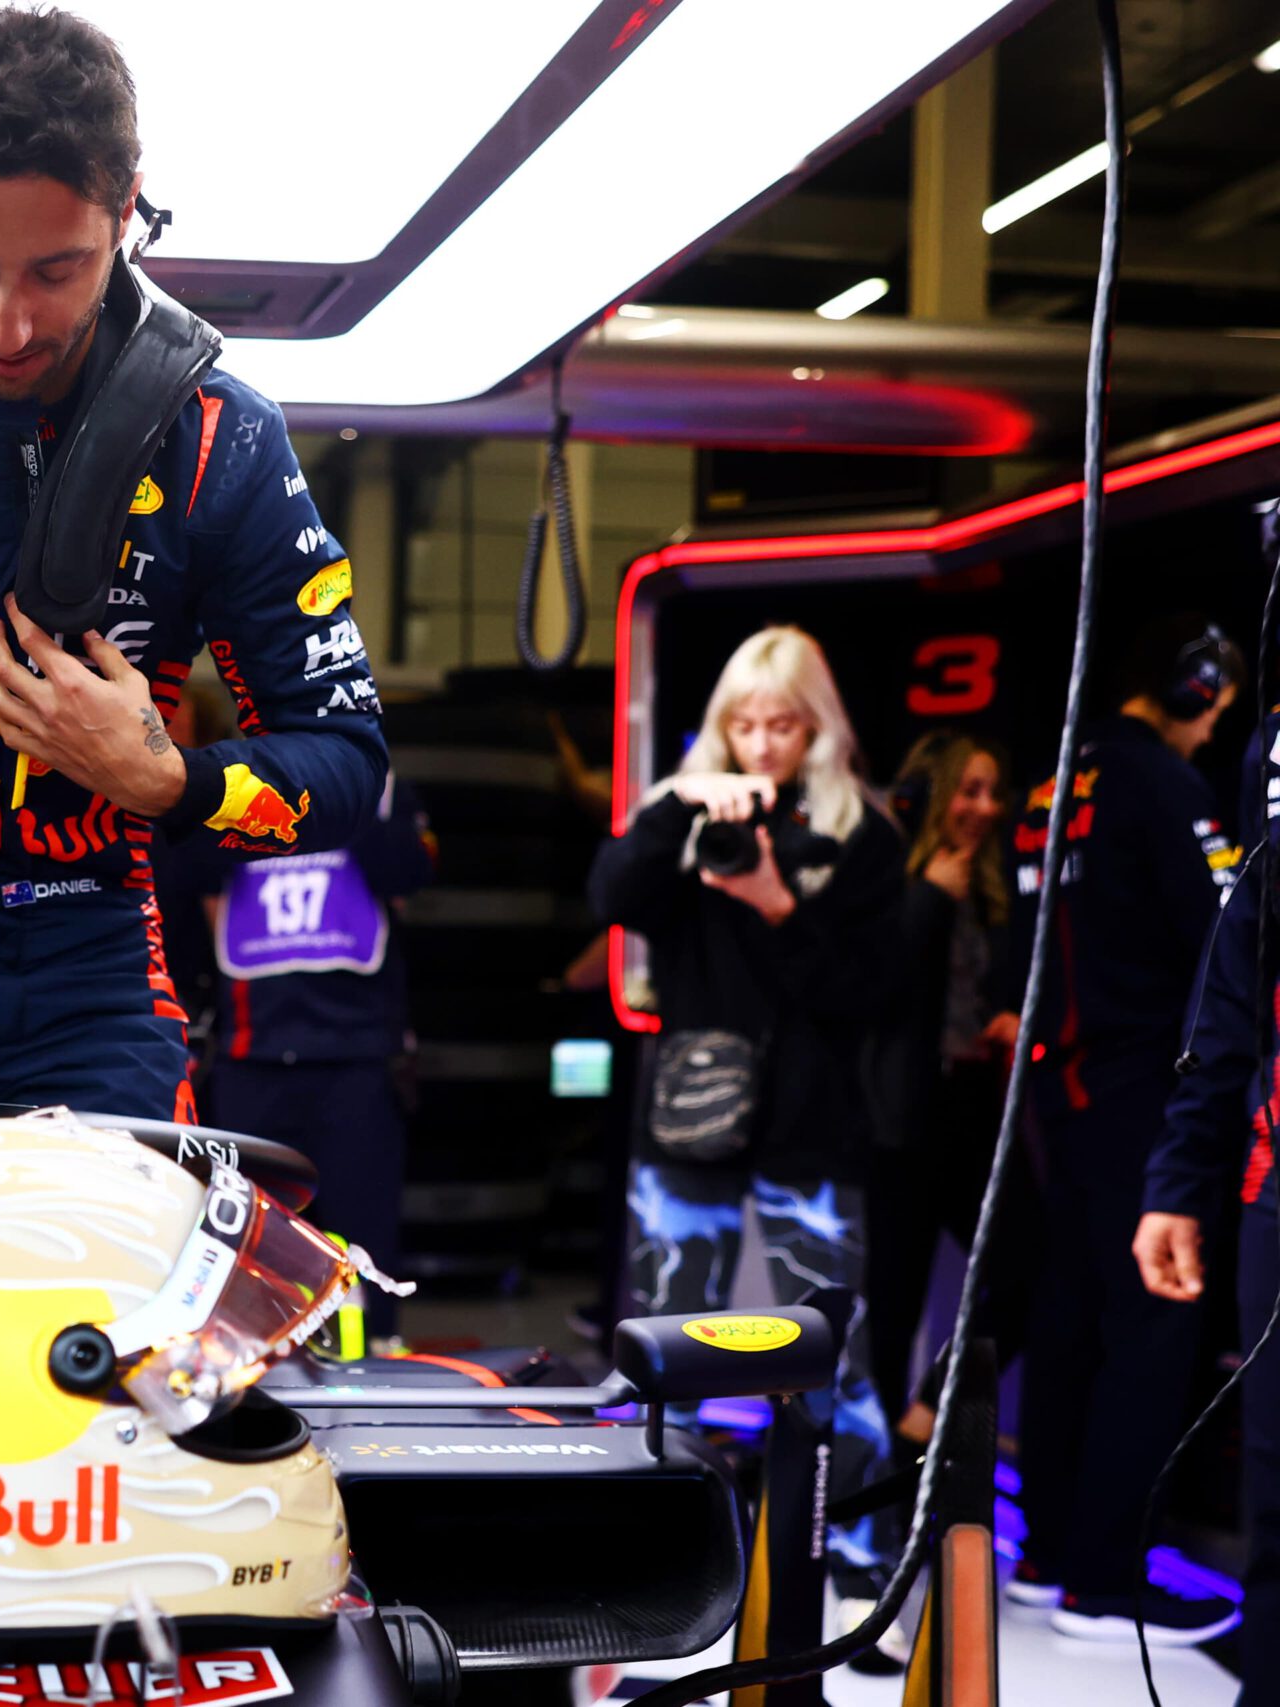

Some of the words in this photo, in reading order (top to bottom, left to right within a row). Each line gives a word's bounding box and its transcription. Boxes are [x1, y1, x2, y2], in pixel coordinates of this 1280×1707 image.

[317, 571, 352, 602] RAUC
[304, 659, 353, 681] Honda
[907, 635, 1000, 715] 3
[350, 677, 376, 700] ARC
[35, 879, 102, 899] DANIEL
[411, 1443, 609, 1456] Walmart
[231, 1556, 293, 1587] BYBIT
